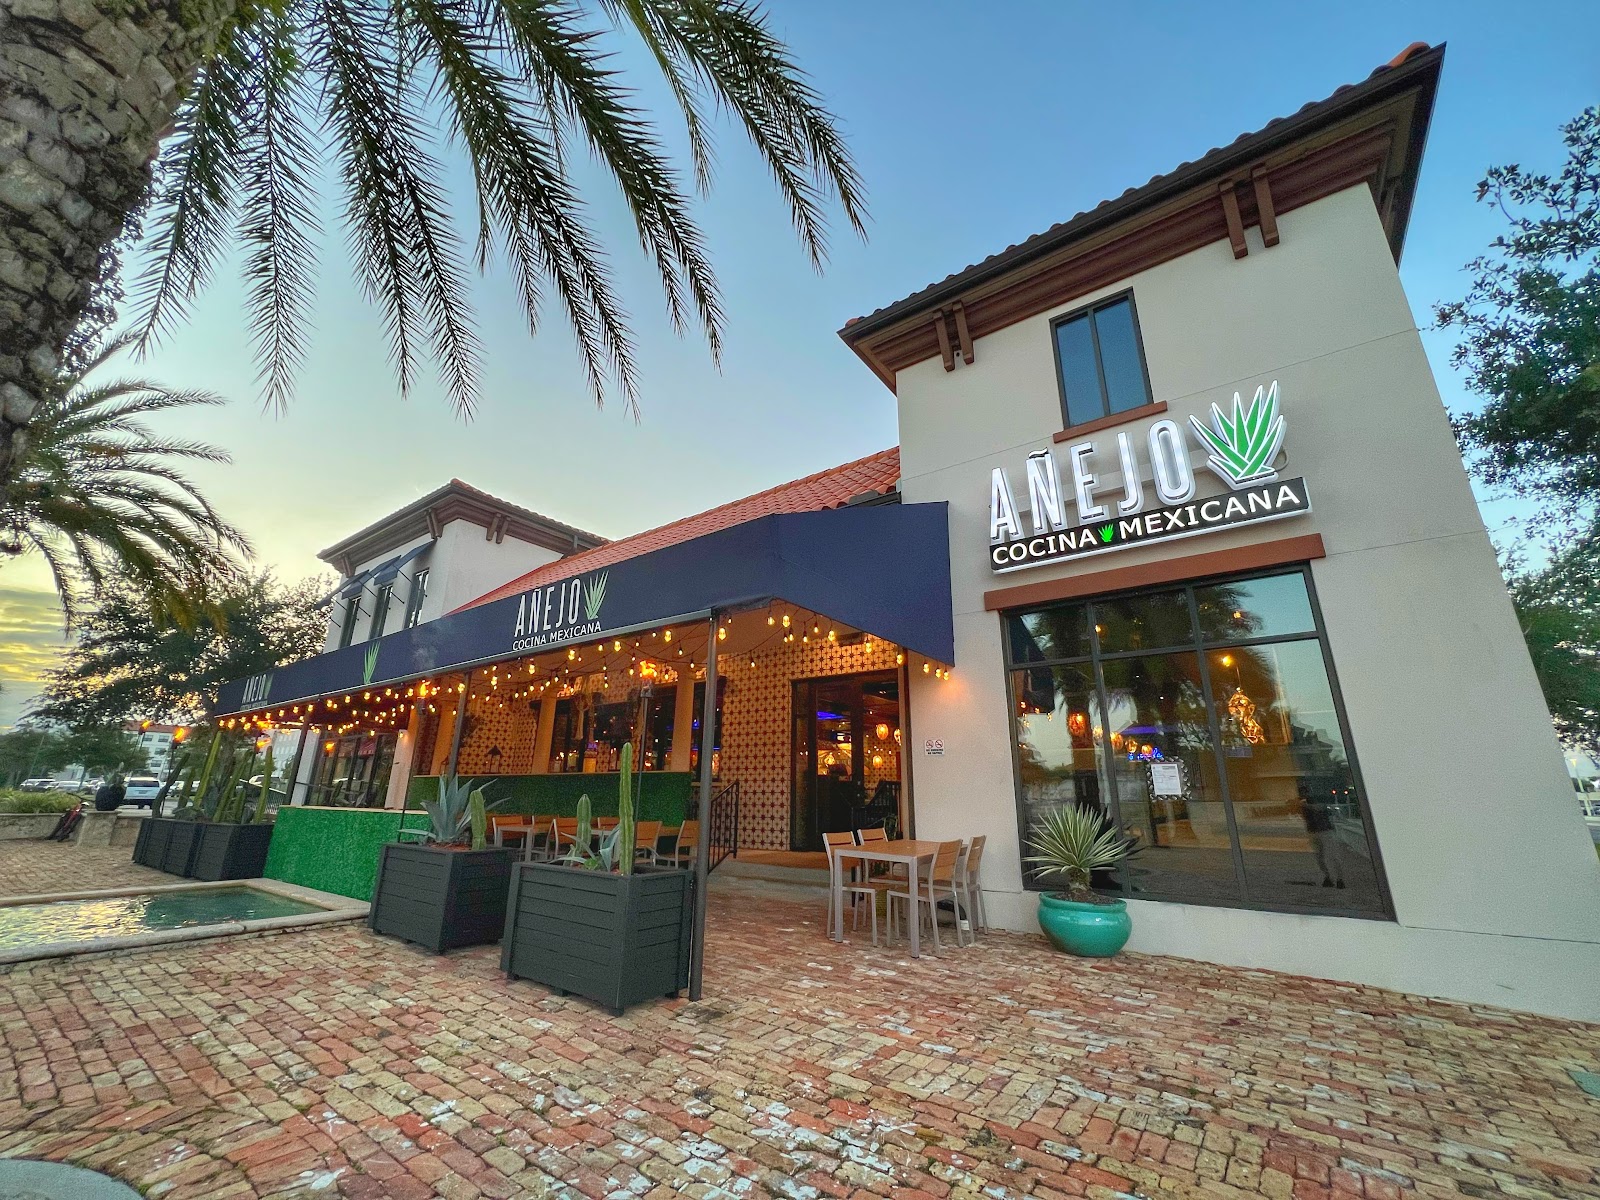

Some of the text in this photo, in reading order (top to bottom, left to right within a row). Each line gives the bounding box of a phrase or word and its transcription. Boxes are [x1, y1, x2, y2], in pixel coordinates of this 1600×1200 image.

[990, 419, 1196, 541] AÑEJO
[992, 485, 1301, 565] COCINA MEXICANA
[512, 621, 602, 651] COCINA MEXICANA
[514, 578, 581, 638] AÑEJO
